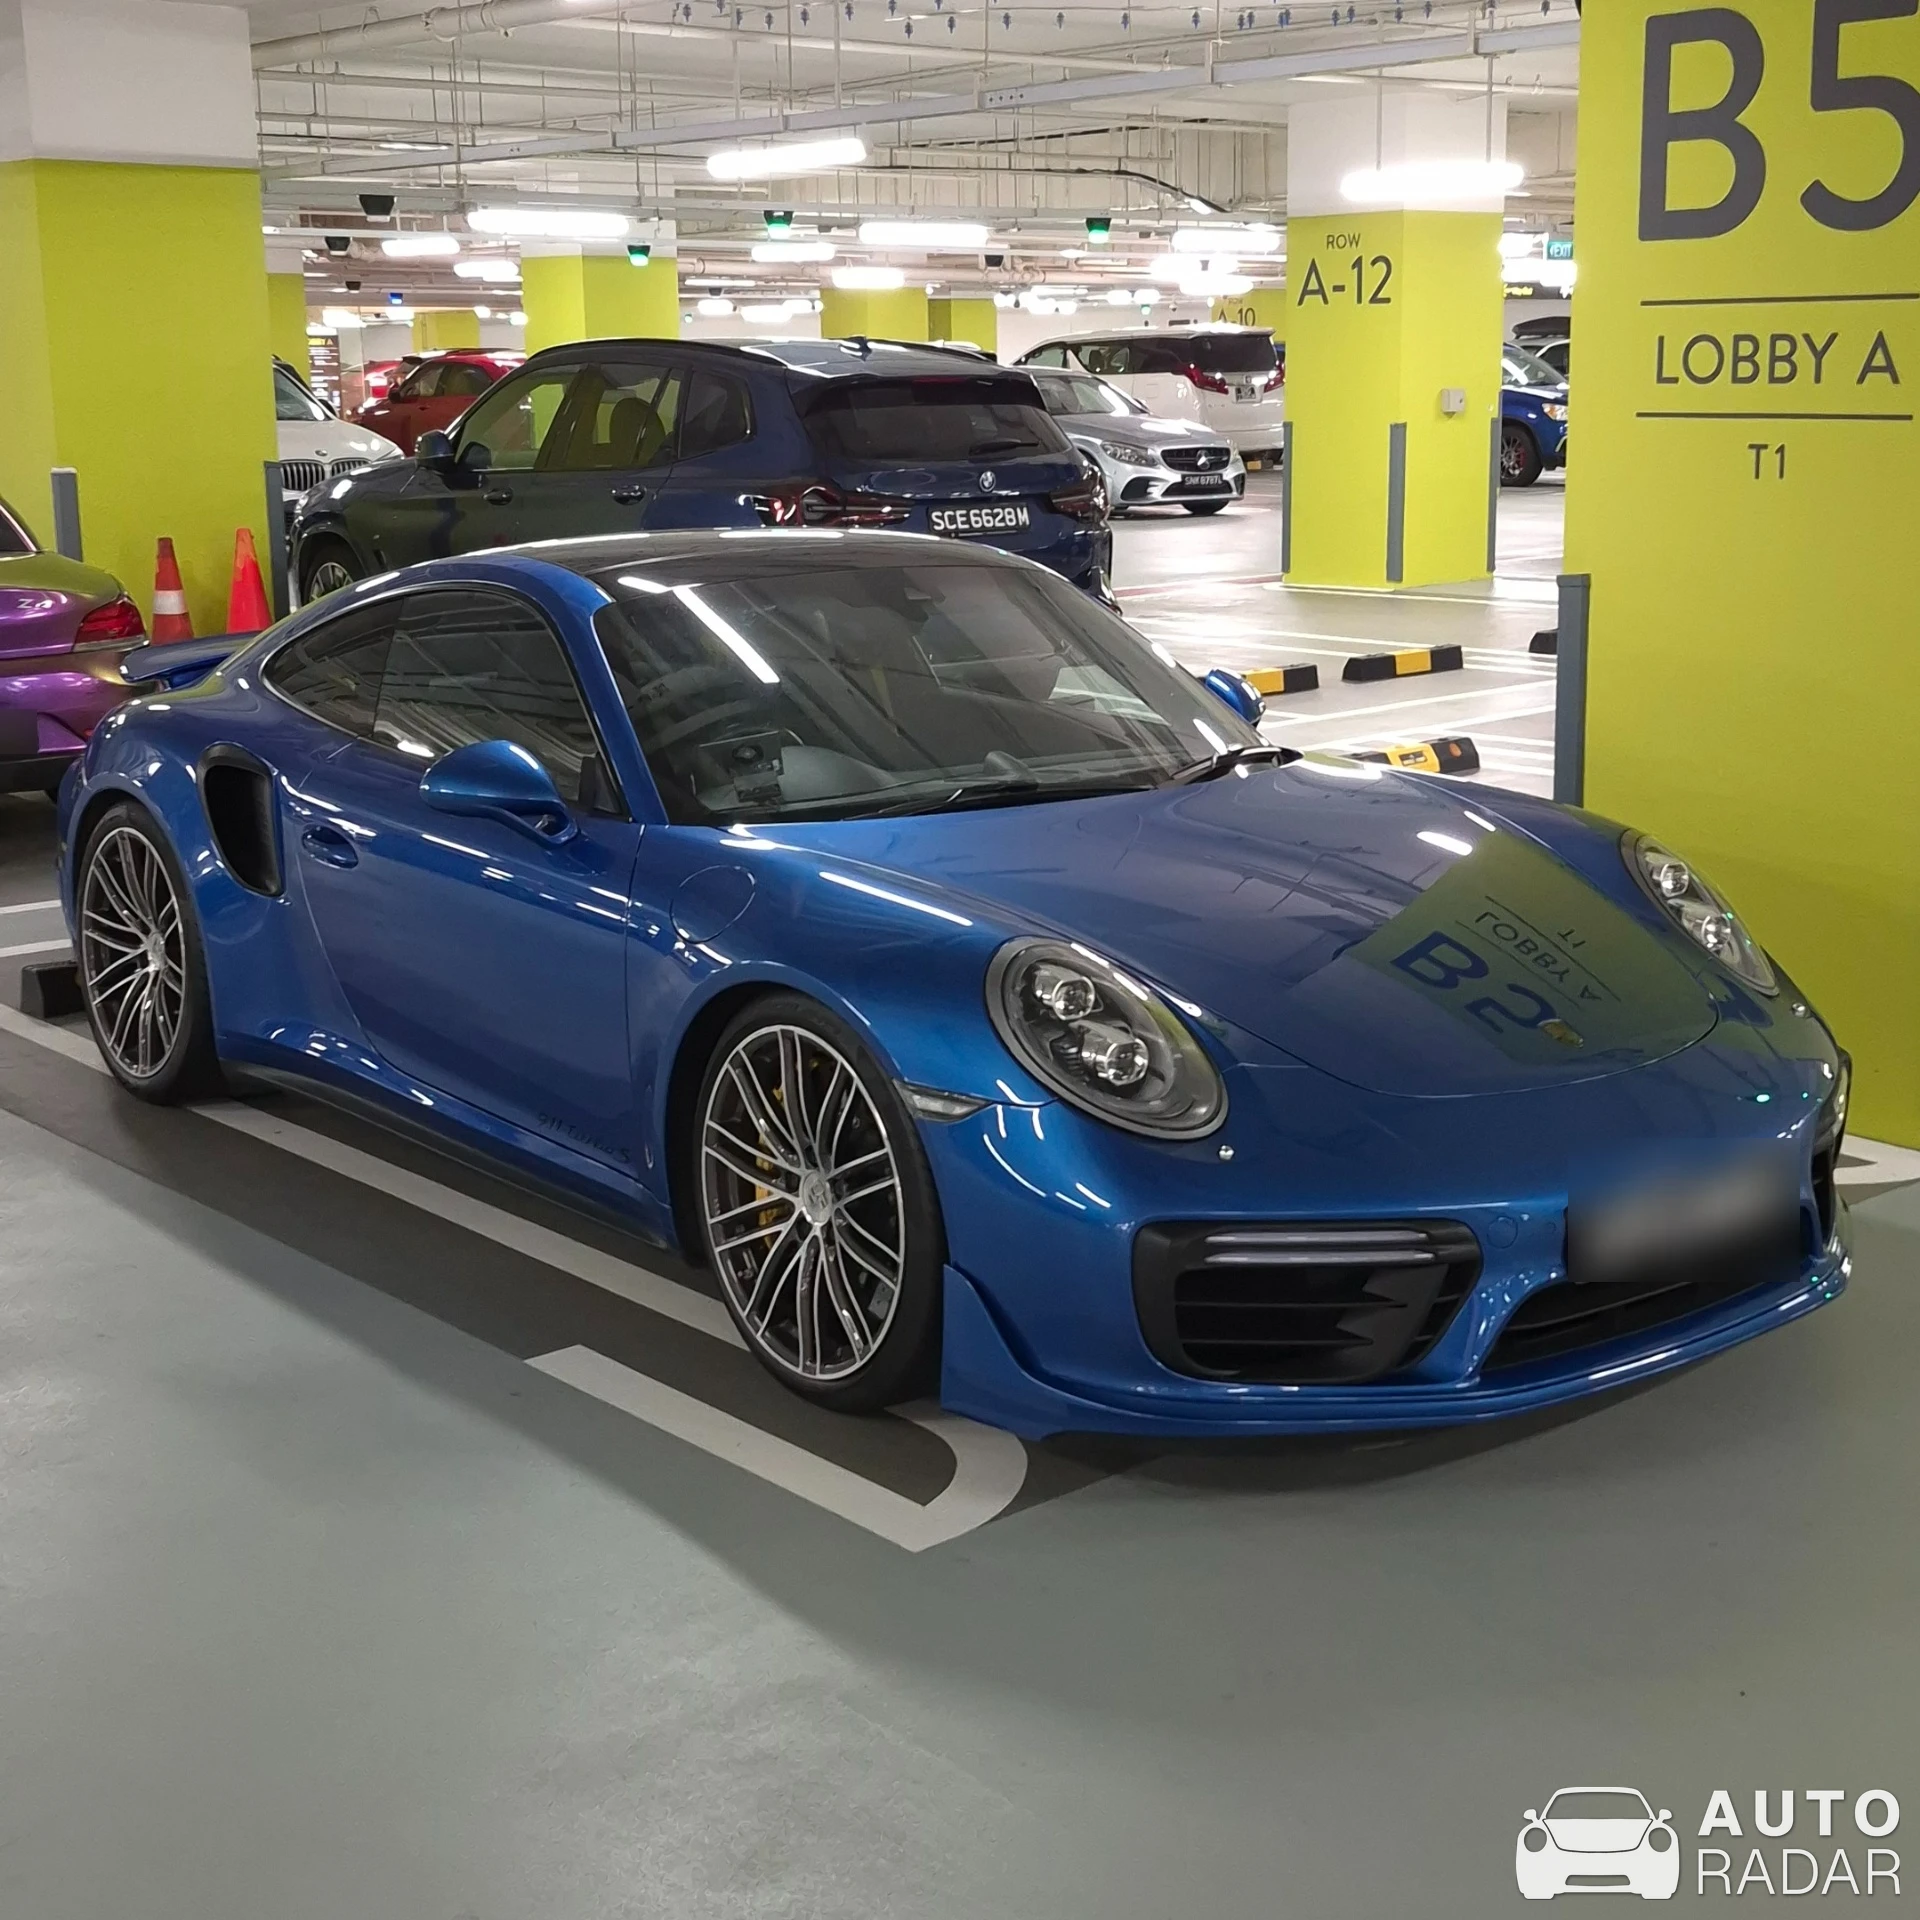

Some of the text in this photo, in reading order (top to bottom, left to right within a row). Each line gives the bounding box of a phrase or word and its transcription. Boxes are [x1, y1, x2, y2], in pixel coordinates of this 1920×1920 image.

[1639, 0, 1920, 241] B5
[1326, 233, 1361, 250] ROW
[1298, 255, 1392, 306] A-12
[1656, 330, 1900, 385] LOBBY A
[1748, 444, 1785, 479] T1
[931, 507, 1030, 531] SCE6628M
